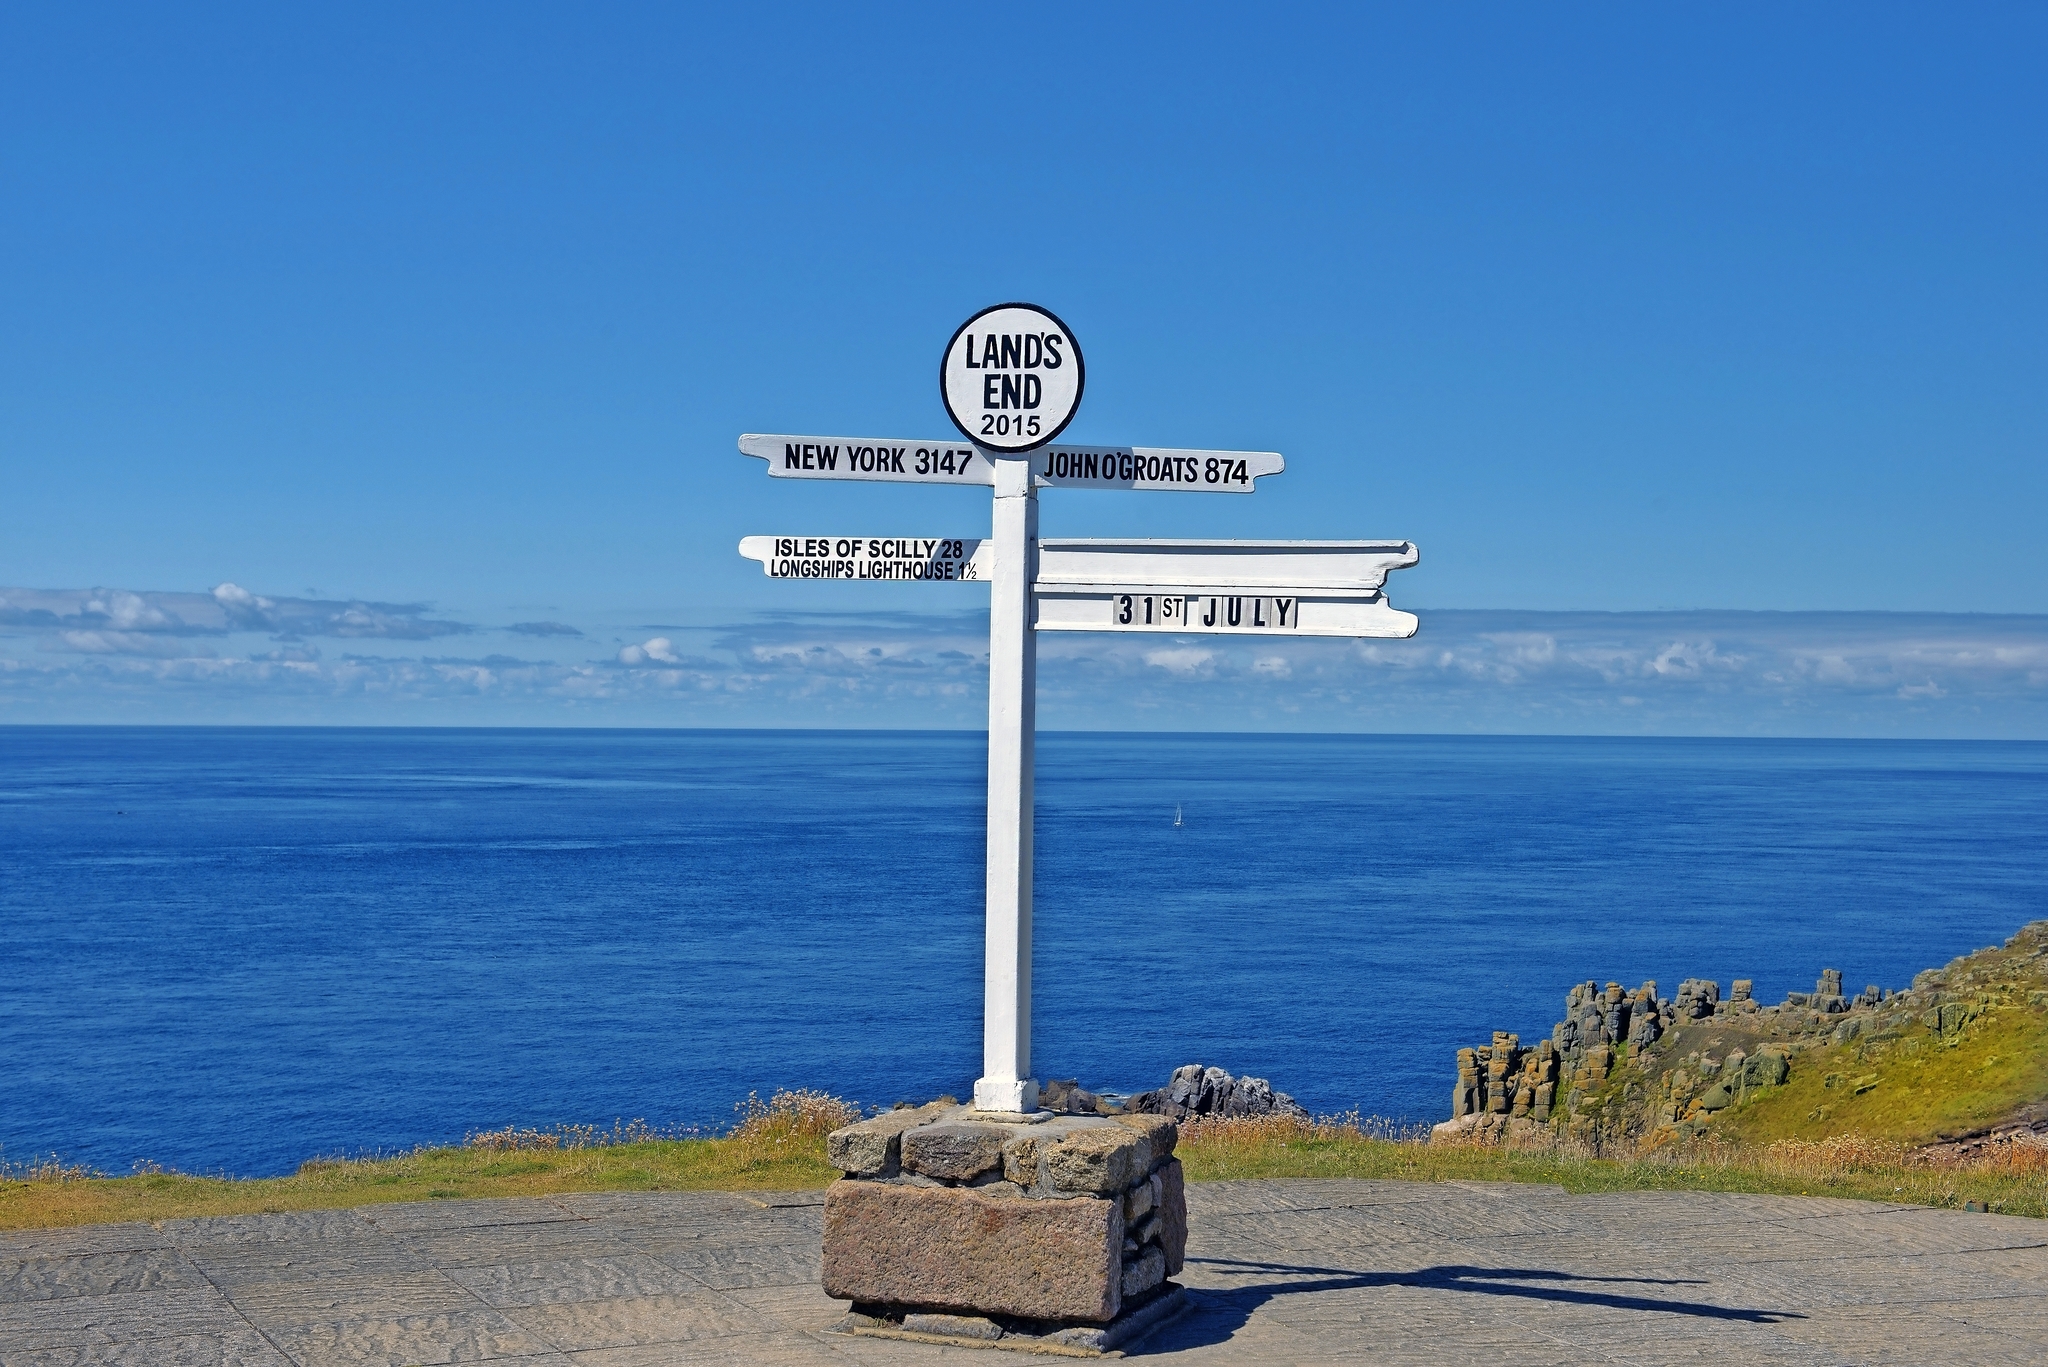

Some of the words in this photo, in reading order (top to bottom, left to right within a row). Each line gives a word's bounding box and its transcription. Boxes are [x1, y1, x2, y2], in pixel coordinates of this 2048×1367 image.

[966, 332, 1062, 369] LAND'S
[983, 373, 1041, 409] END
[980, 414, 1040, 436] 2015
[785, 444, 839, 471] NEW
[847, 446, 905, 473] YORK
[915, 448, 973, 475] 3147
[1044, 452, 1098, 478] JOHN
[1102, 451, 1198, 483] O'GROATS
[1204, 457, 1249, 484] 874
[775, 539, 830, 557] ISLES
[836, 540, 863, 557] OF
[868, 540, 936, 558] SCILLY
[941, 540, 963, 558] 28
[771, 559, 854, 578] LONGSHIPS
[858, 561, 953, 580] LIGHTHOUSE
[1203, 597, 1291, 627] JULY
